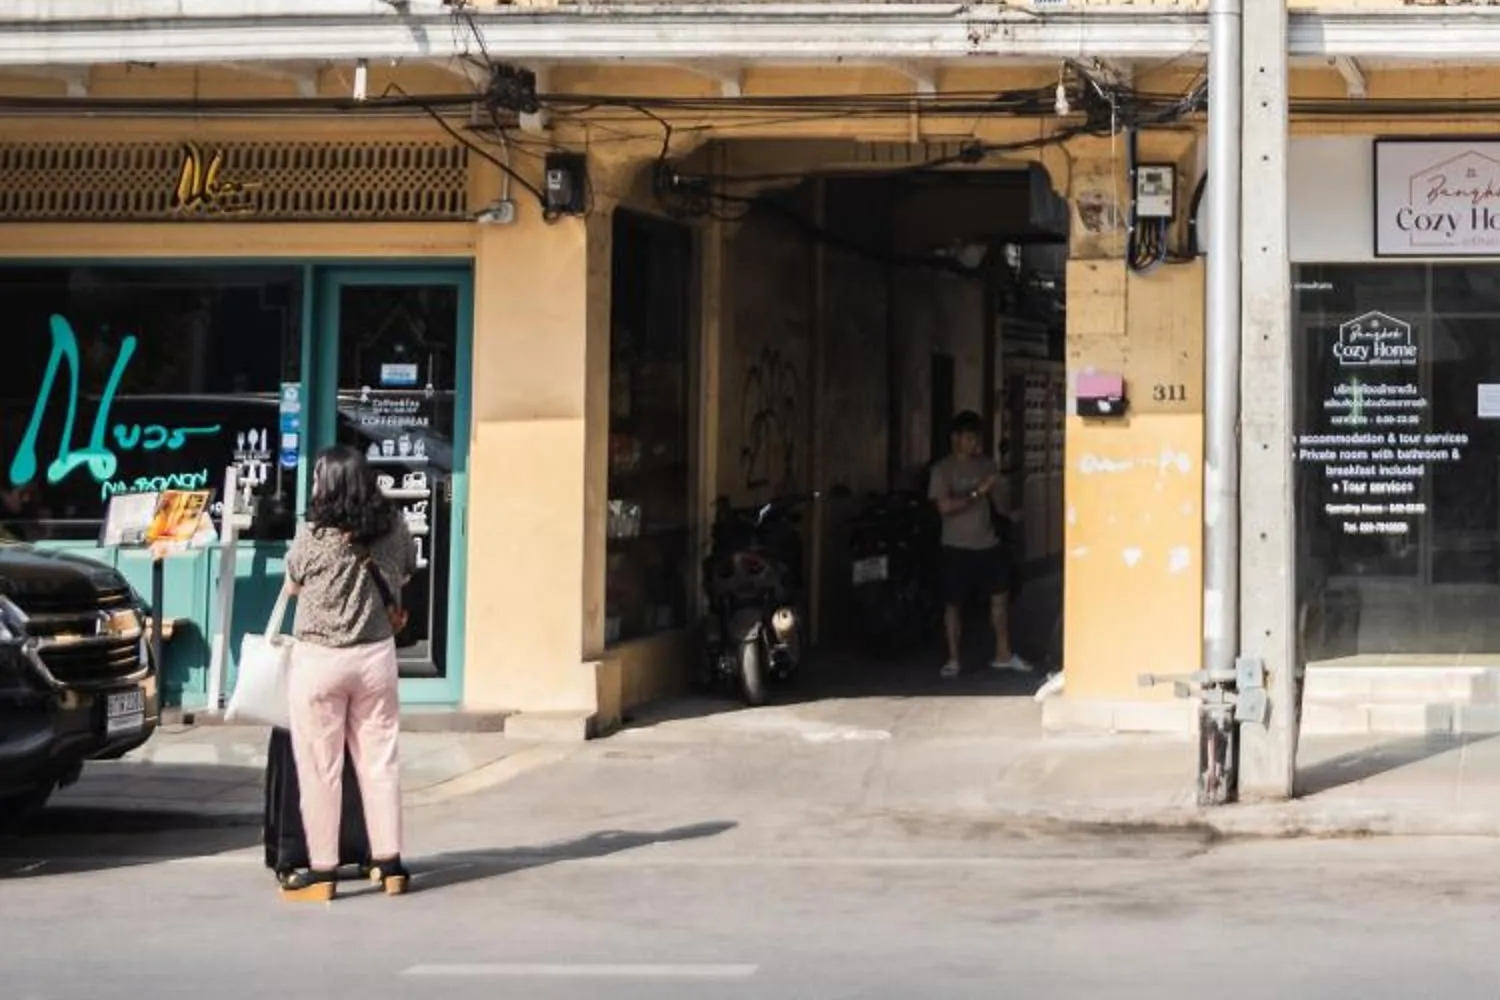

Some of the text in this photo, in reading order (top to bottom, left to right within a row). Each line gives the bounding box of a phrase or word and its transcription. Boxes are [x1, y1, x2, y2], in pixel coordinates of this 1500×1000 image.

[1396, 207, 1458, 237] Cozy
[1333, 342, 1417, 360] Cozy Home
[1152, 383, 1188, 401] 311
[1300, 433, 1384, 445] accommodation
[1399, 433, 1421, 444] tour
[1424, 433, 1469, 445] services
[1300, 448, 1337, 460] Private
[1339, 450, 1368, 460] room
[1371, 449, 1394, 460] with
[1397, 448, 1449, 460] bathroom
[1325, 464, 1425, 477] breakfast included
[1342, 480, 1414, 495] Tour services
